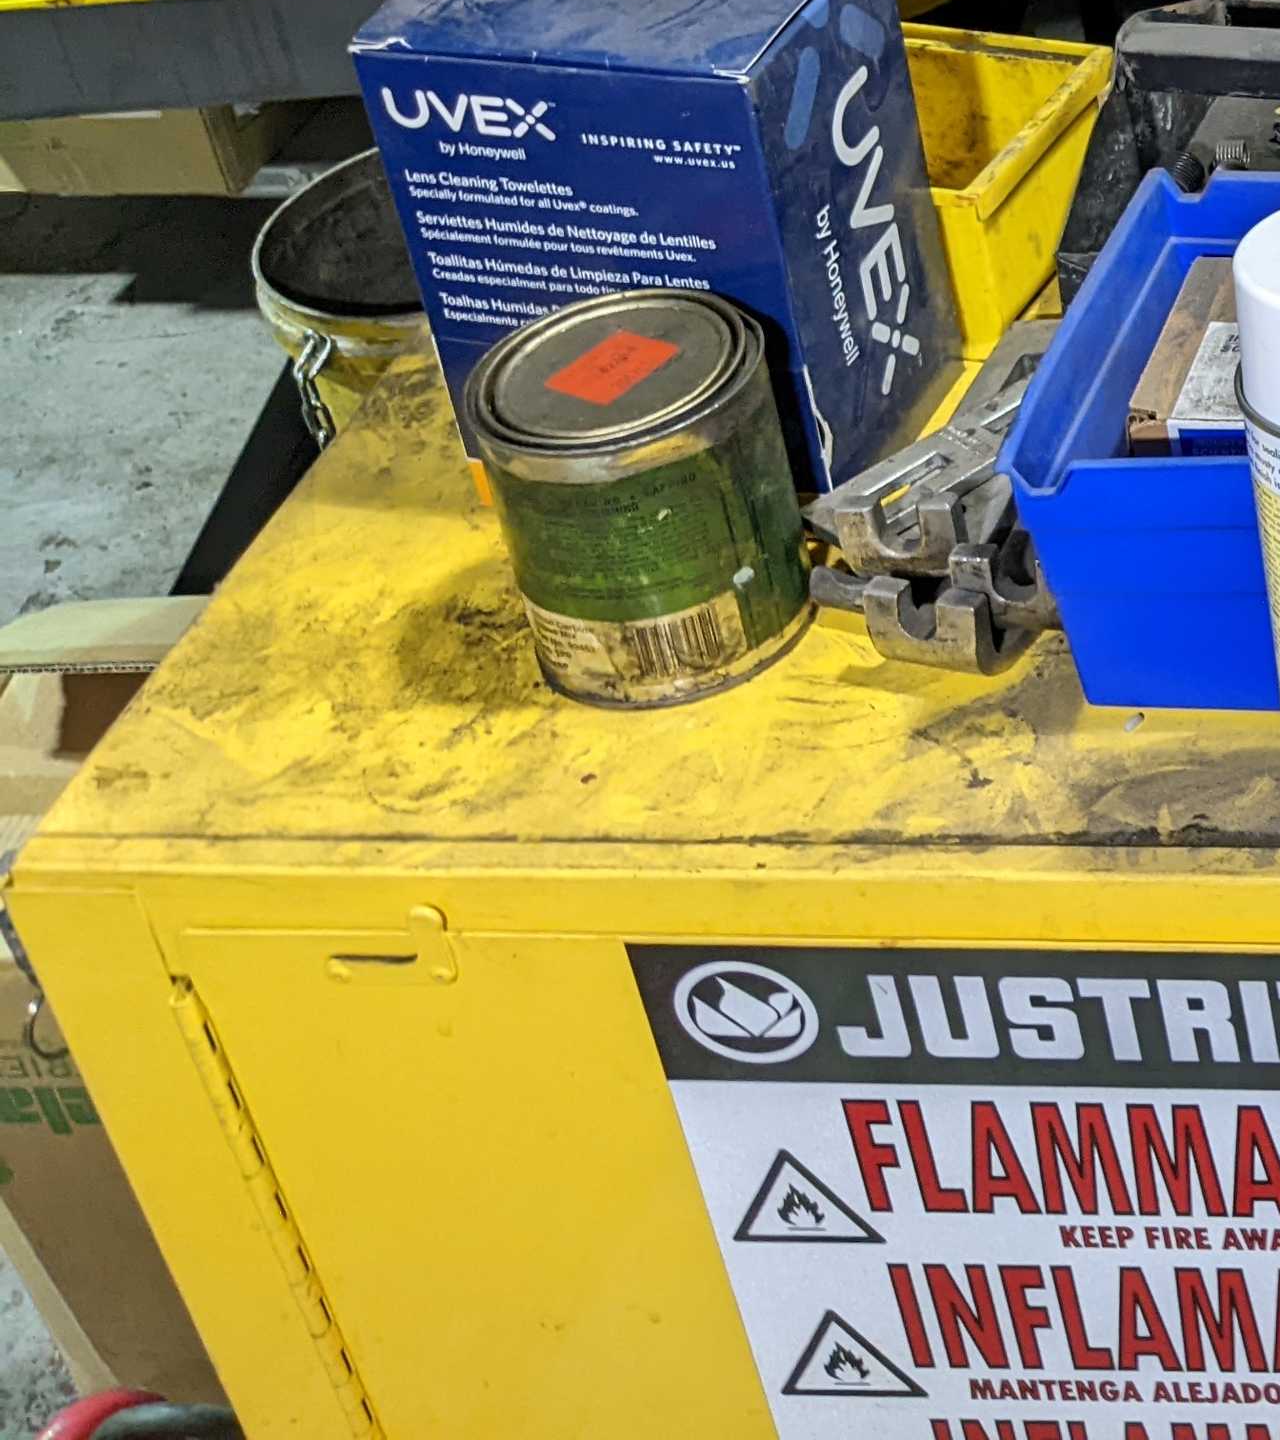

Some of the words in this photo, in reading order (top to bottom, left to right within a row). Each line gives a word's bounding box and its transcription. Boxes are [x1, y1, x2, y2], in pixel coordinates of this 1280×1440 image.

[381, 87, 557, 141] UVEX
[439, 141, 456, 157] by
[459, 142, 526, 161] Honeywell
[581, 133, 667, 151] INSPIRING
[653, 154, 736, 170] www.uvex.us
[404, 168, 437, 185] Lens
[438, 171, 499, 192] Cleaning
[499, 177, 574, 197] Towelettes
[409, 186, 457, 202] Specially
[458, 189, 519, 206] formulated
[520, 195, 536, 208] for
[538, 197, 552, 209] all
[589, 203, 640, 218] coatings.
[416, 210, 484, 231] Serviettes
[485, 216, 545, 236] Humides
[547, 222, 565, 238] de
[566, 225, 638, 246] Nettoyage
[639, 231, 657, 245] de
[659, 233, 717, 251] Lentilles
[816, 204, 831, 240] by
[832, 65, 921, 396] UVEX
[420, 227, 492, 246] Spécialement
[492, 231, 542, 249] formulée
[543, 239, 569, 253] pour
[570, 241, 595, 254] tous
[596, 243, 664, 260] revêtements
[664, 249, 697, 262] Uvex.
[427, 251, 483, 270] Toallitas
[485, 256, 549, 277] Húmedas
[551, 265, 568, 279] de
[569, 266, 630, 285] Limpieza
[632, 271, 662, 287] Para
[663, 274, 710, 290] Lentes
[432, 268, 477, 284] Creadas
[477, 272, 547, 291] especialment
[548, 280, 574, 294] para
[574, 282, 600, 296] todo
[439, 291, 489, 310] Toalhas
[491, 298, 549, 316] Humidas
[823, 239, 861, 367] Honeywell
[443, 308, 519, 328] Especialmente
[1060, 1224, 1134, 1250] KEEP
[1146, 1225, 1211, 1251] FIRE
[970, 1378, 1146, 1405] MANTENGA
